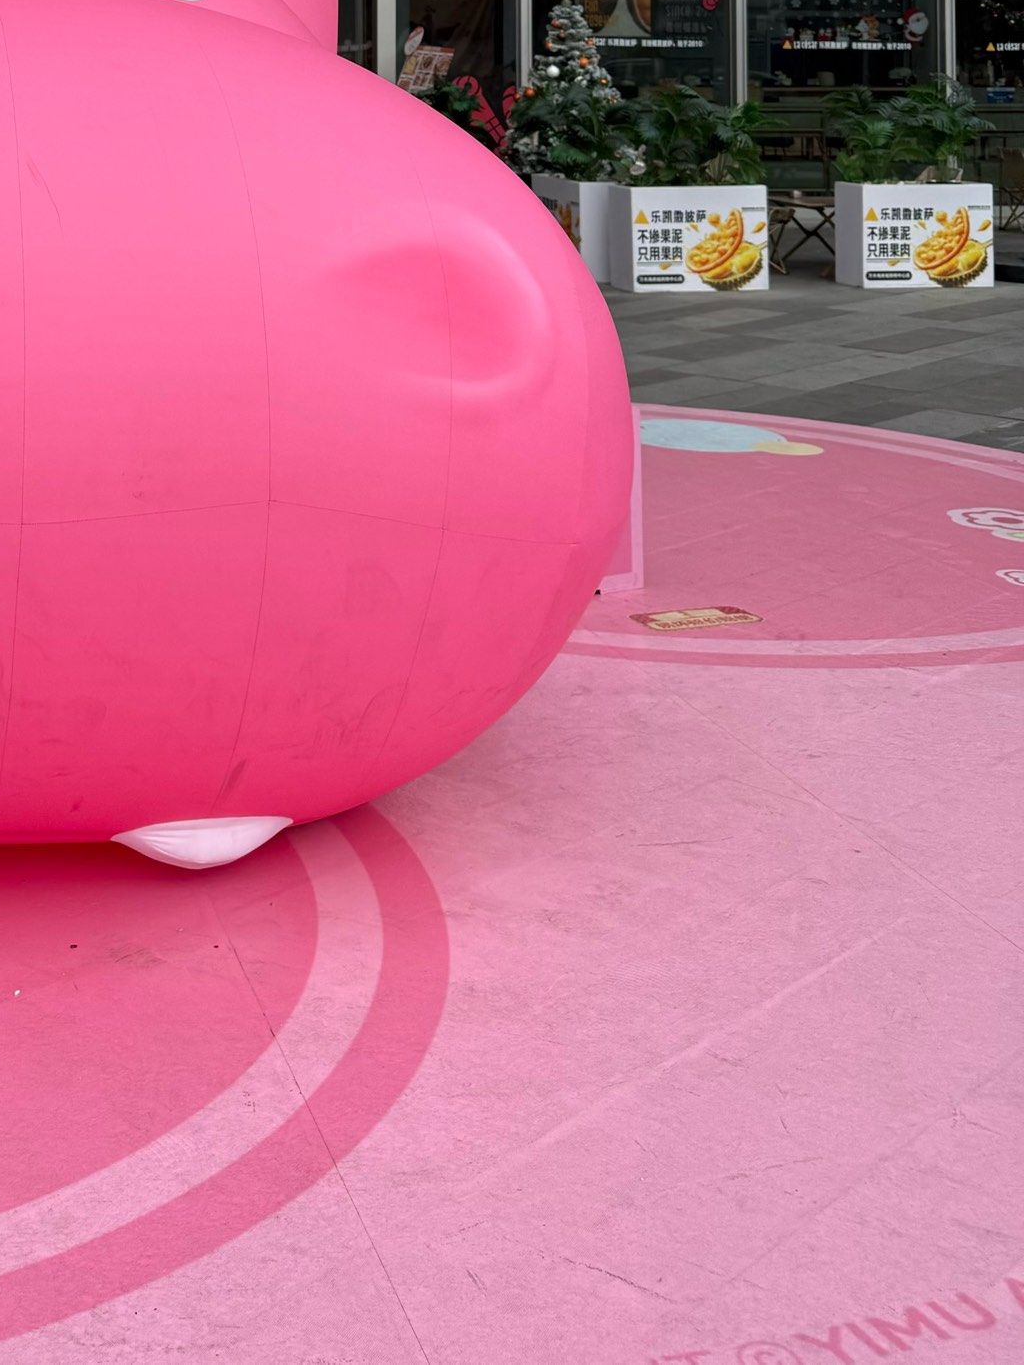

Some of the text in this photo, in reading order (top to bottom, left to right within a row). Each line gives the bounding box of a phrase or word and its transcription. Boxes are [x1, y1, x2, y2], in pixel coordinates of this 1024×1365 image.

[637, 229, 683, 244] 不掺果泥
[867, 226, 911, 241] 不掺果泥
[637, 246, 683, 261] 只用果肉
[867, 243, 911, 258] 只用果肉
